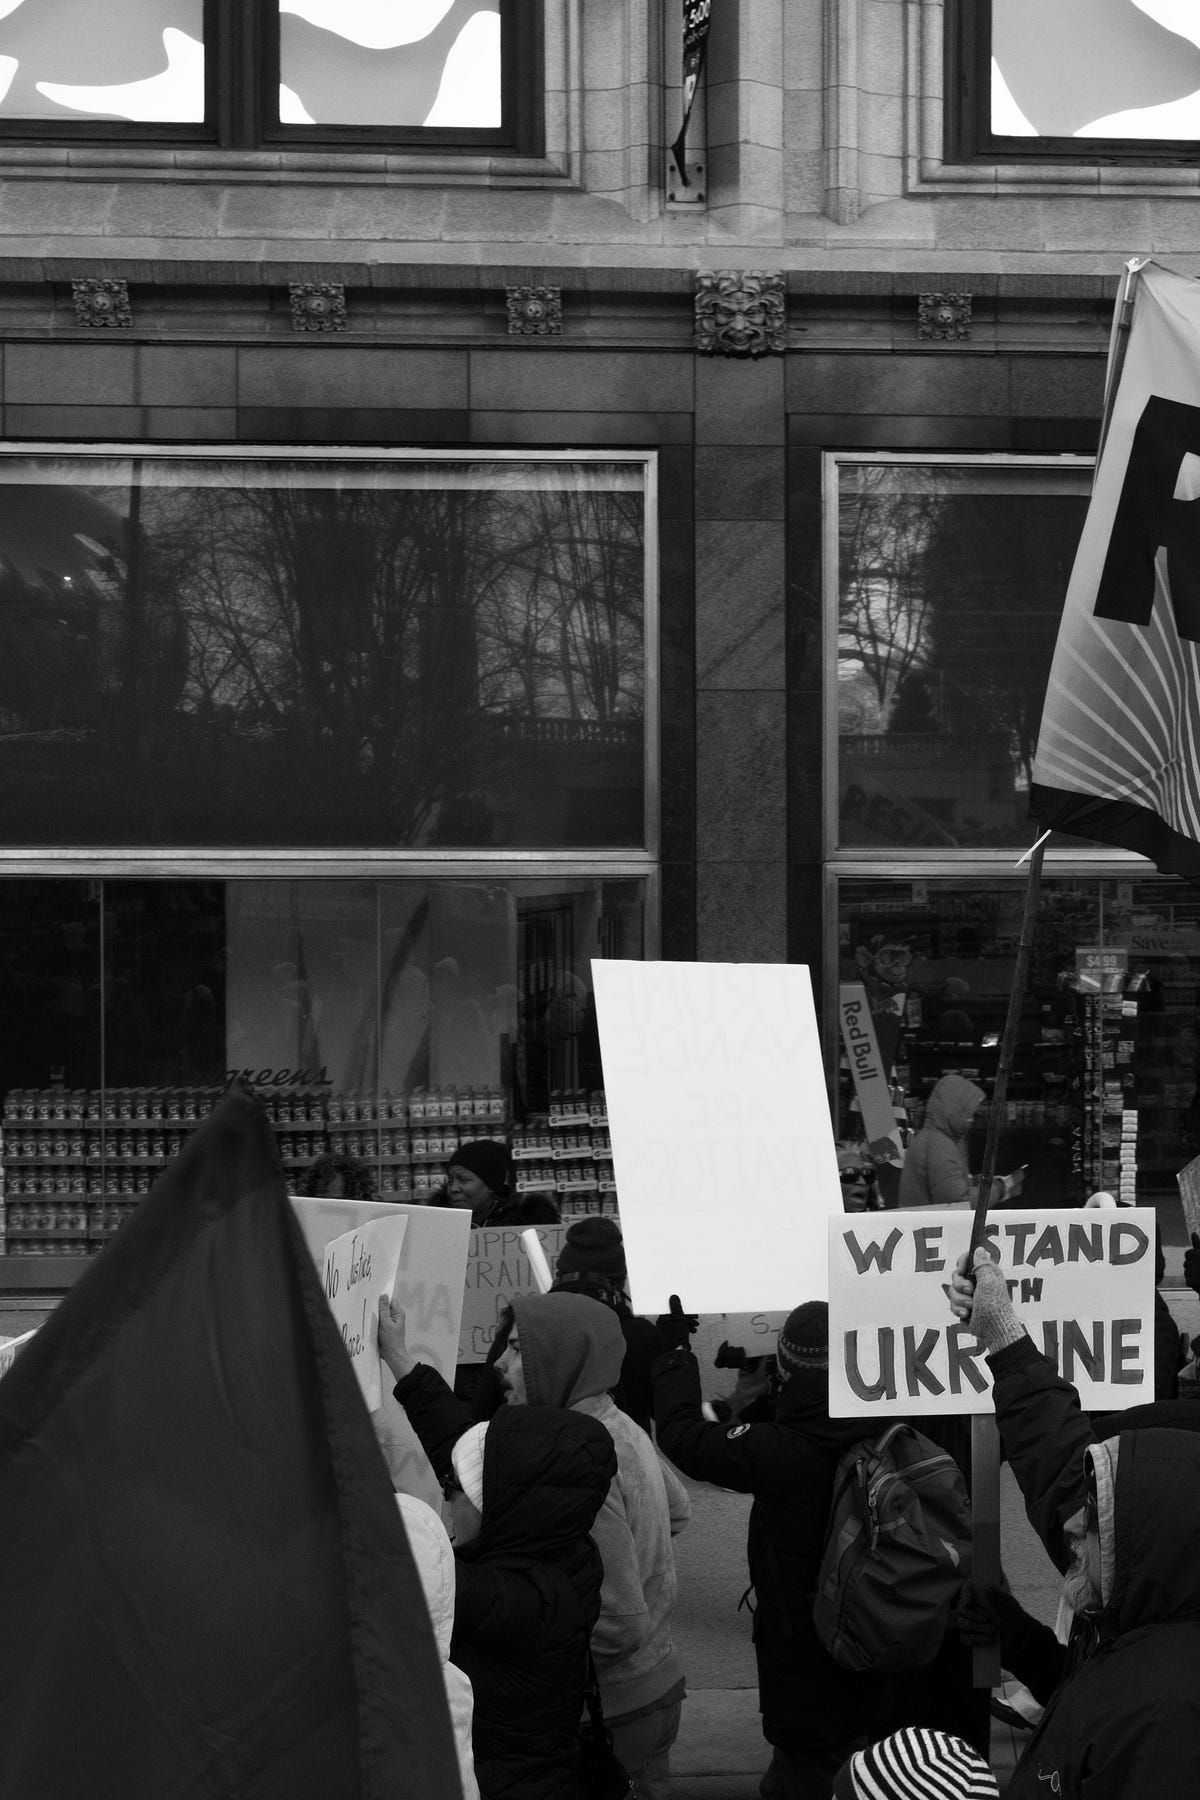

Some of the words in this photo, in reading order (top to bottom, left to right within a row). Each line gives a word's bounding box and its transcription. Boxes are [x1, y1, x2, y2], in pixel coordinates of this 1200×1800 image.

[1086, 955, 1118, 969] $499
[1131, 935, 1169, 950] Save
[842, 1000, 869, 1041] Red
[851, 1041, 879, 1081] Bull
[842, 1225, 946, 1275] WE
[326, 1251, 340, 1300] No
[844, 1318, 1145, 1402] UKRINE
